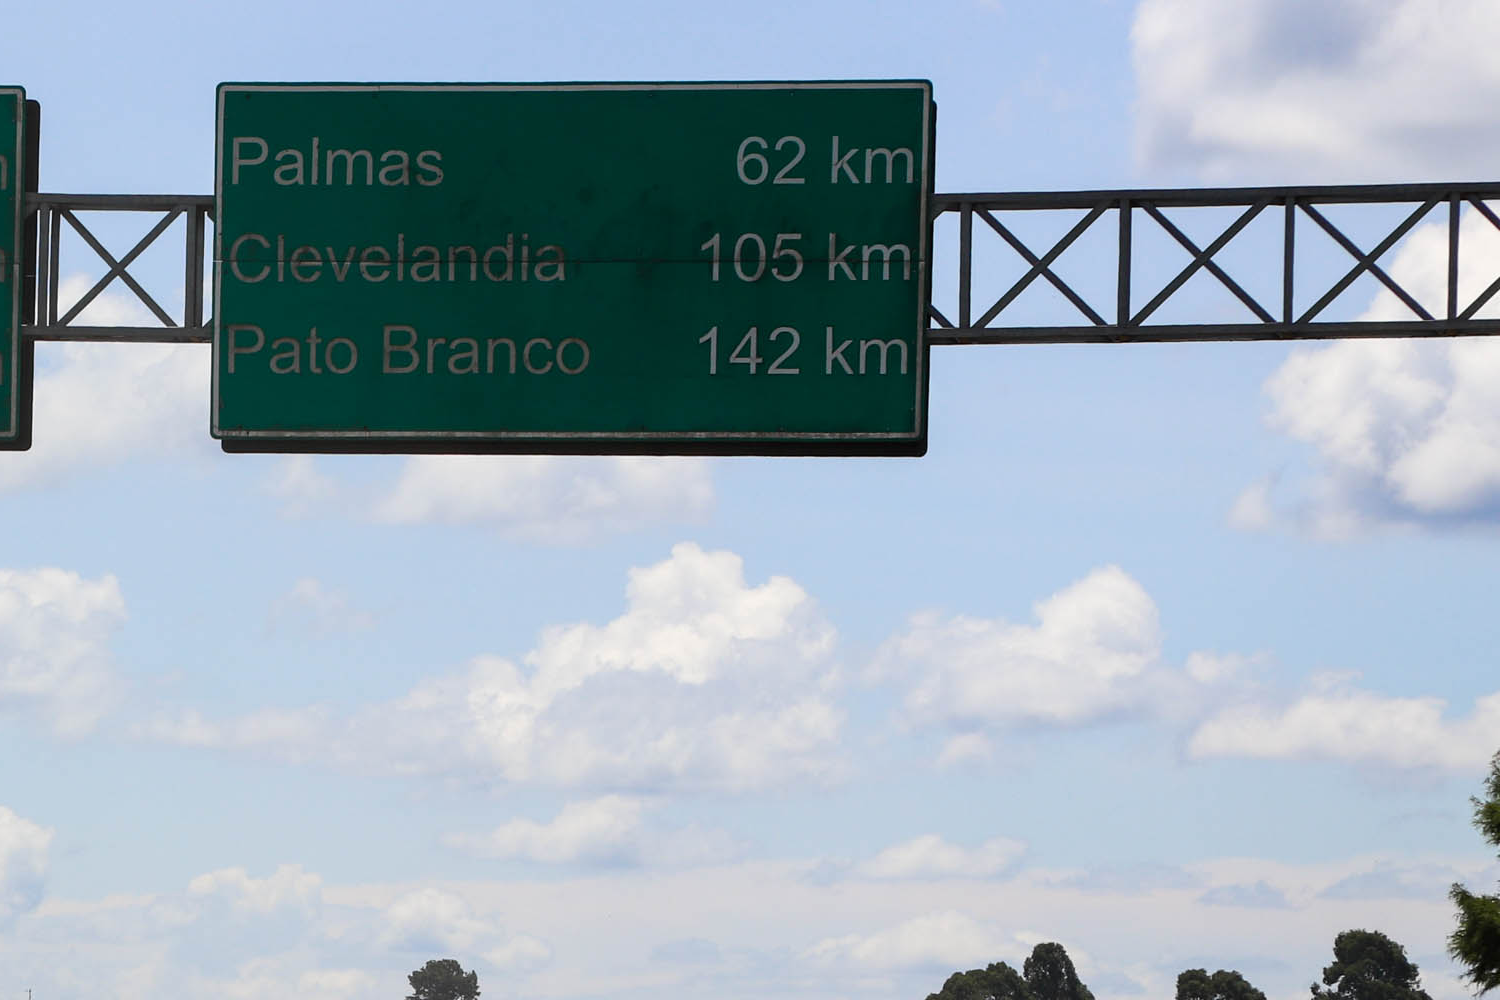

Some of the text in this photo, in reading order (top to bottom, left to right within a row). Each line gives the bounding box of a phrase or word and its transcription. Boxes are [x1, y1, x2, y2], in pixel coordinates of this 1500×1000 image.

[231, 136, 444, 186] Palmas
[736, 136, 914, 185] 62 km
[228, 233, 566, 284] Clevelandia
[700, 233, 911, 282] 105 km
[226, 325, 591, 375] Pato Branco
[699, 326, 908, 375] 142 km
